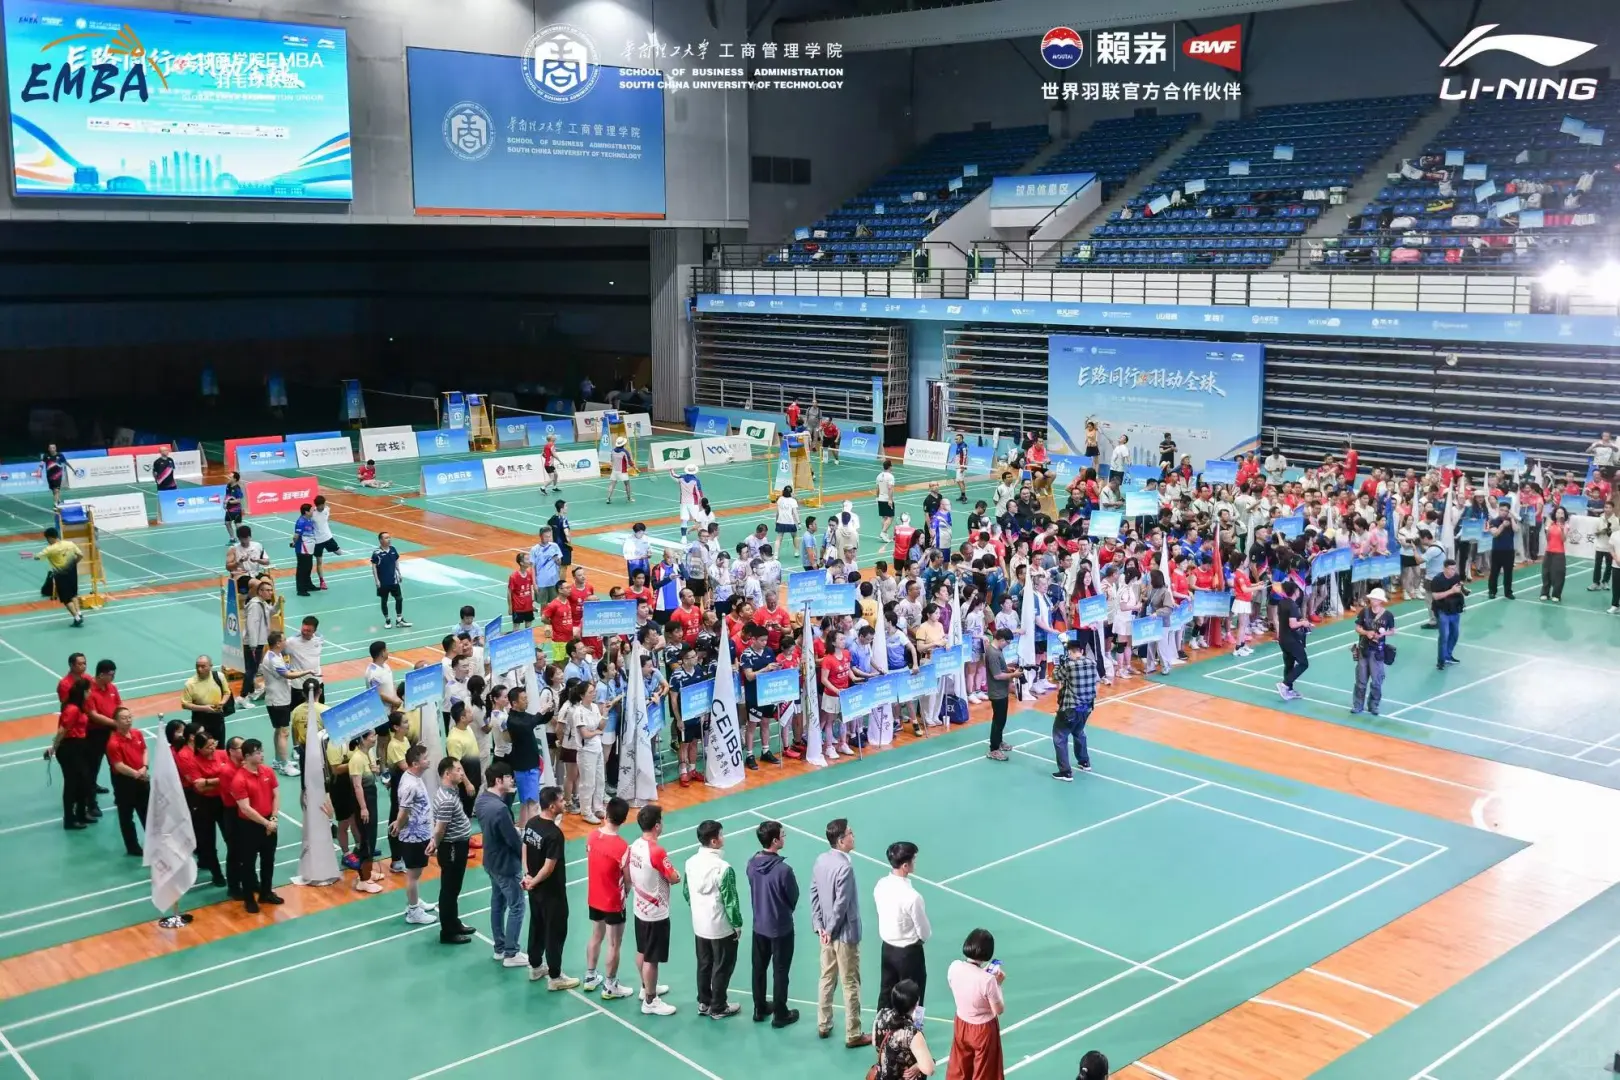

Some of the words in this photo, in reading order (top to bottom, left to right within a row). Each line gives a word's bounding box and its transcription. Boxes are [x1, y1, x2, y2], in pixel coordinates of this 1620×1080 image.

[568, 122, 641, 139] 工商管理学院
[507, 137, 534, 145] SCHOOL
[552, 139, 584, 147] BUSINESS
[589, 142, 641, 151] ADMINISTRATION
[507, 146, 530, 154] SOUTH
[553, 149, 590, 158] UNIVERSITY
[600, 152, 641, 160] TECHNOLOGY
[1078, 365, 1139, 389] E路同行
[1149, 368, 1227, 398] 羽动全球
[781, 461, 789, 470] 16
[228, 616, 238, 632] 02
[711, 698, 744, 768] CEIBS
